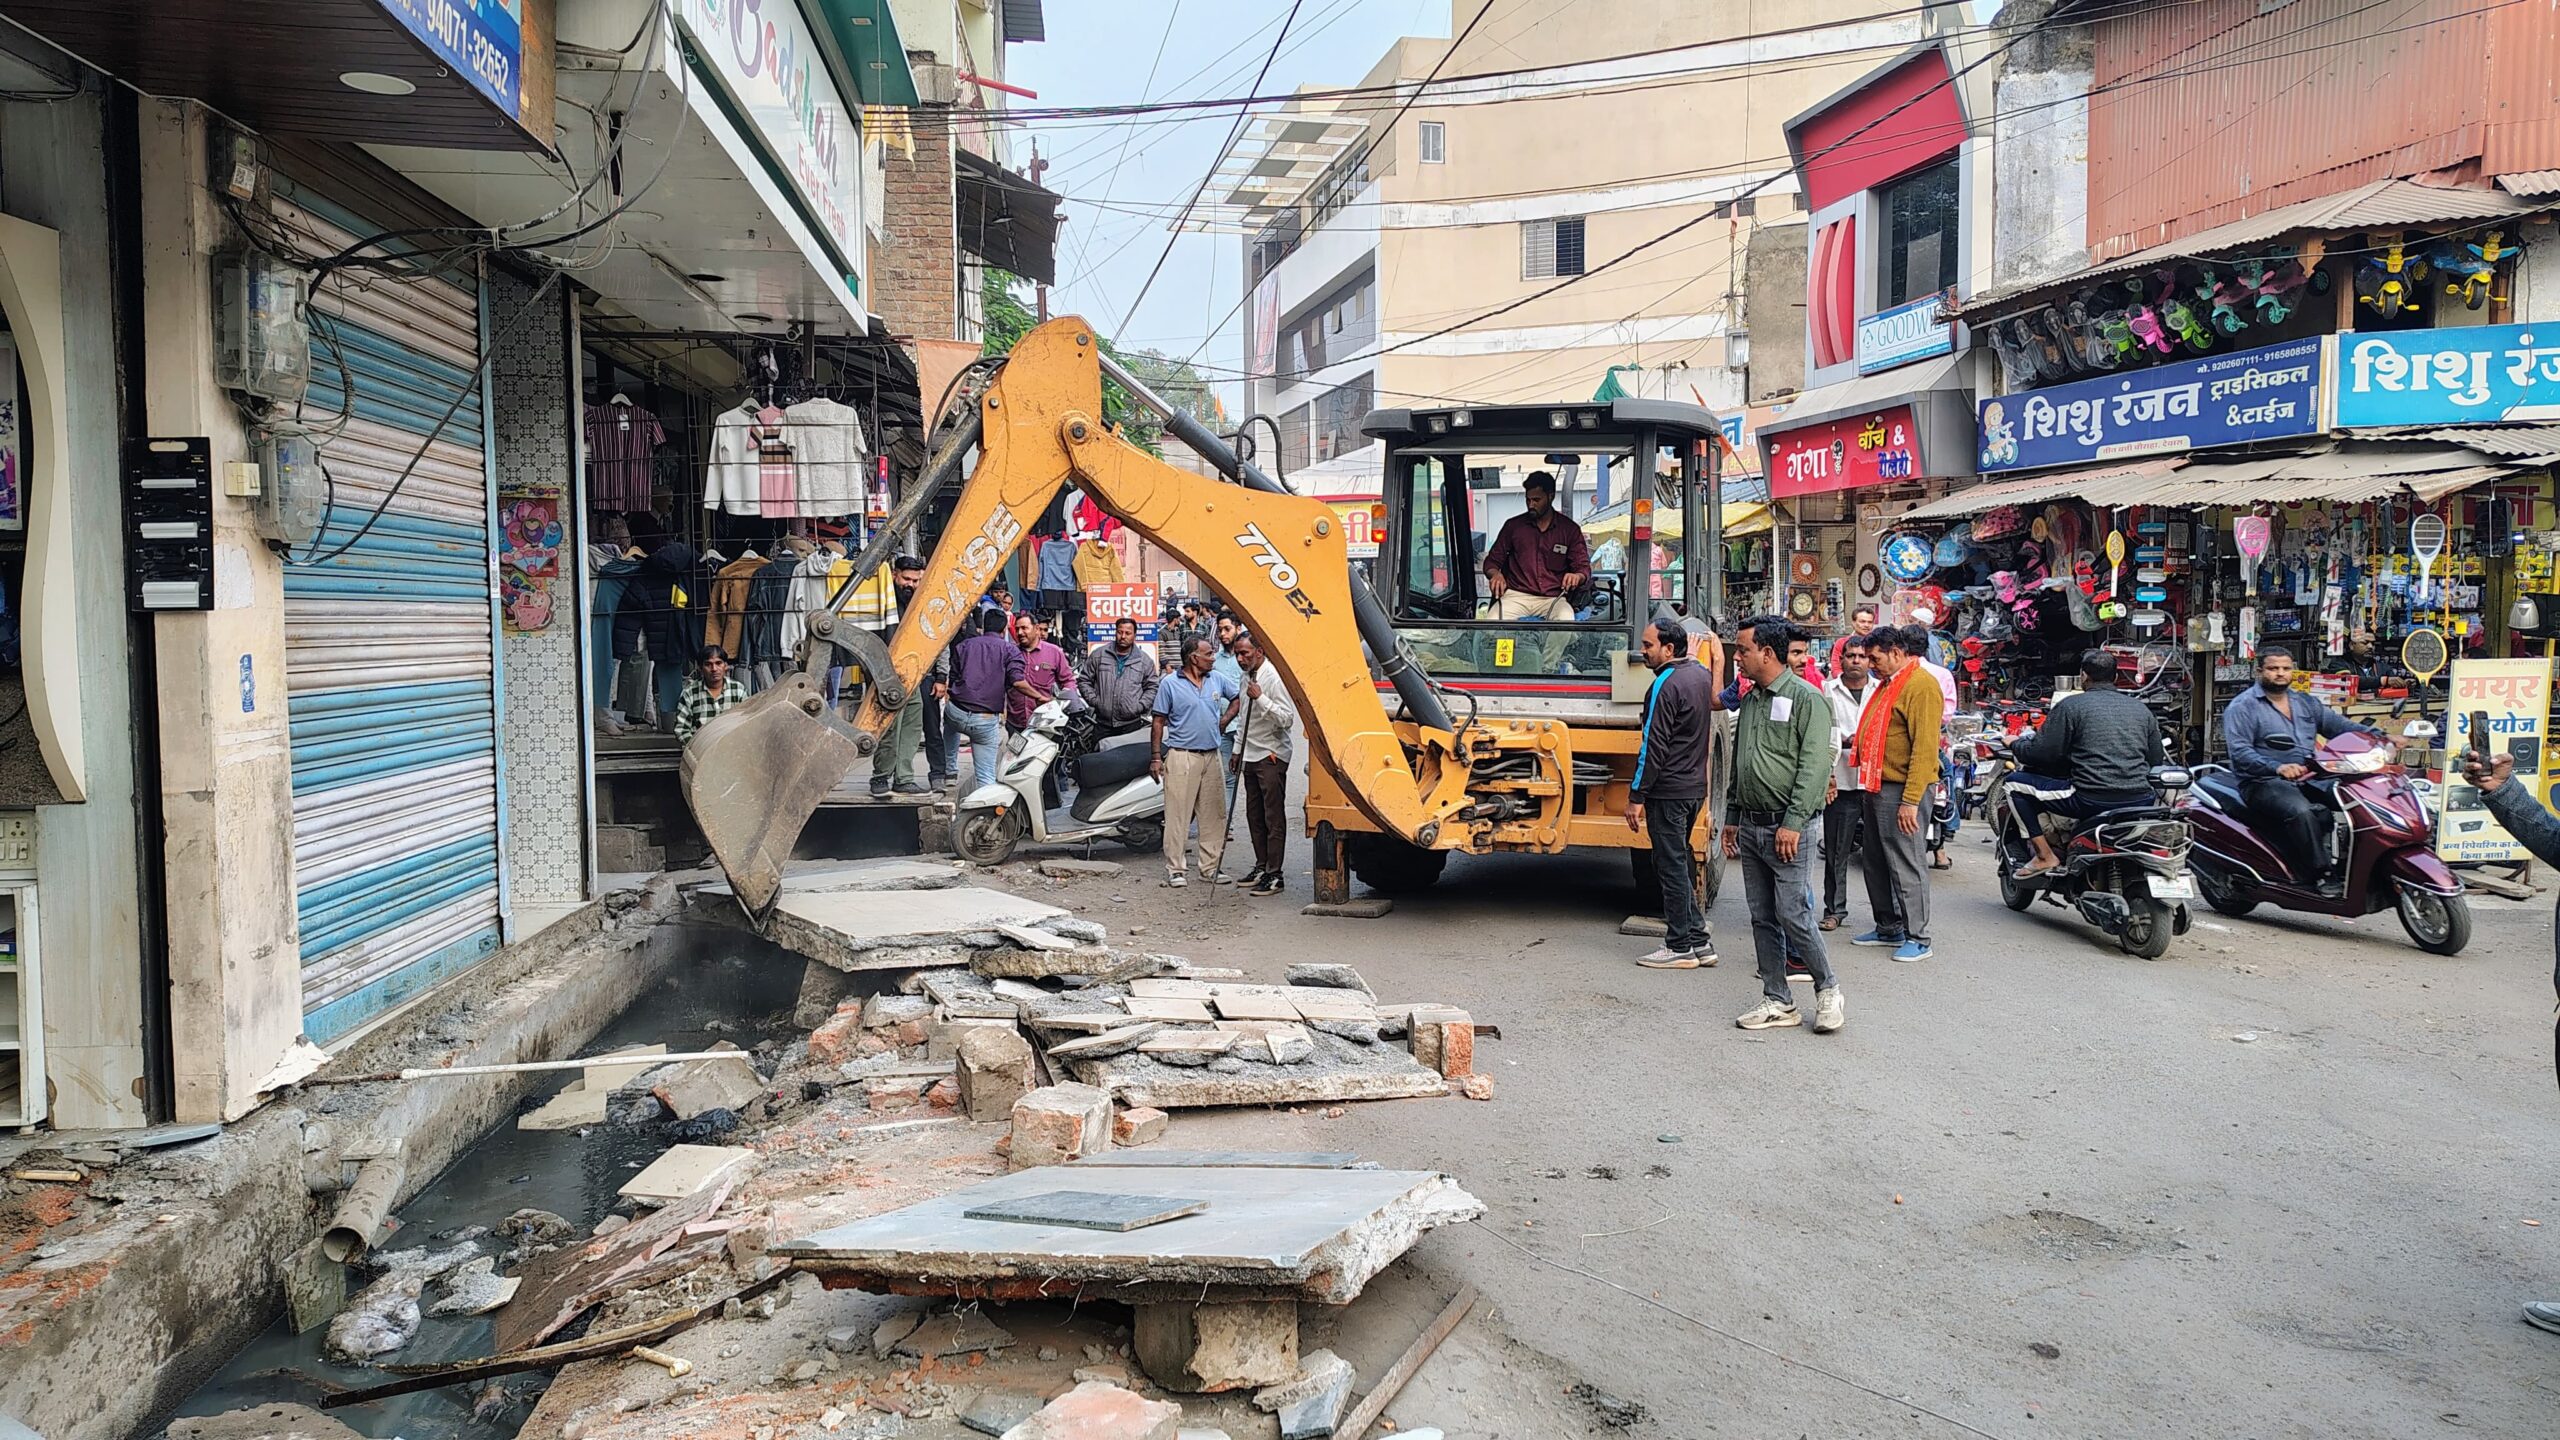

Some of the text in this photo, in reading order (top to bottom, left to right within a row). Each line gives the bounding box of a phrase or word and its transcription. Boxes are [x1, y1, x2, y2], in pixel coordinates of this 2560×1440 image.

[798, 141, 848, 246] Ever Fresh
[2350, 338, 2493, 407] शिशु
[1893, 424, 1906, 446] &
[2022, 380, 2203, 446] शिशु रंजन
[1786, 440, 1829, 482] गंगा
[2458, 675, 2541, 709] मयूर
